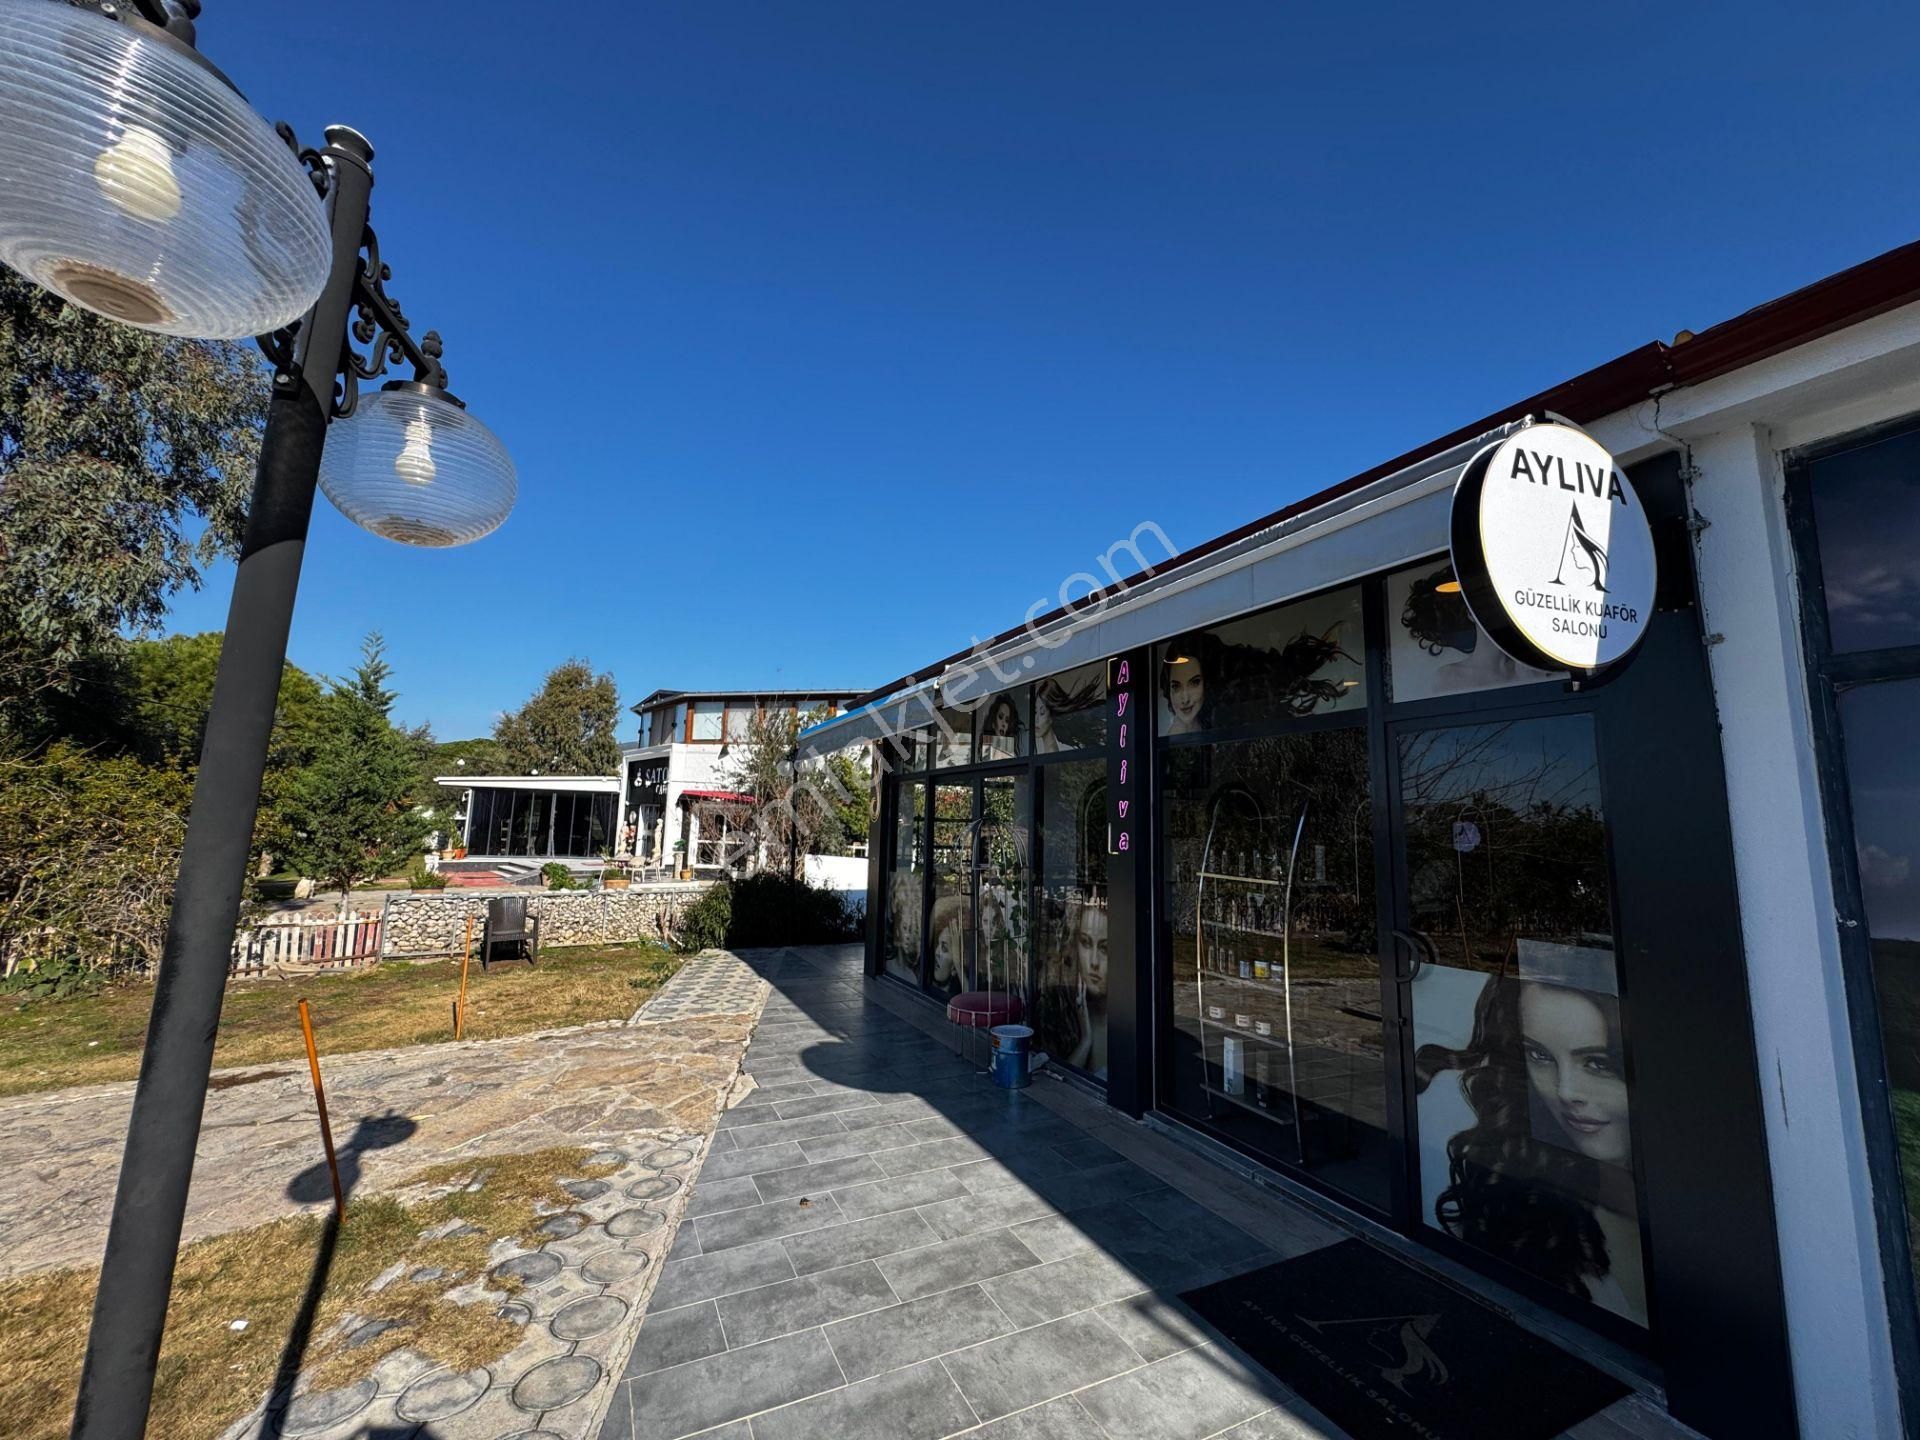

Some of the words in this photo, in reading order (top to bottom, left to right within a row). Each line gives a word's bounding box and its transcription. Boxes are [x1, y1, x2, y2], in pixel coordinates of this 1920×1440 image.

[1510, 447, 1628, 506] AYLIVA
[1514, 588, 1582, 615] GÜZELLİK
[1585, 602, 1638, 624] KUAFÖR
[1552, 617, 1608, 639] SALONU
[1117, 660, 1130, 851] Ayliva
